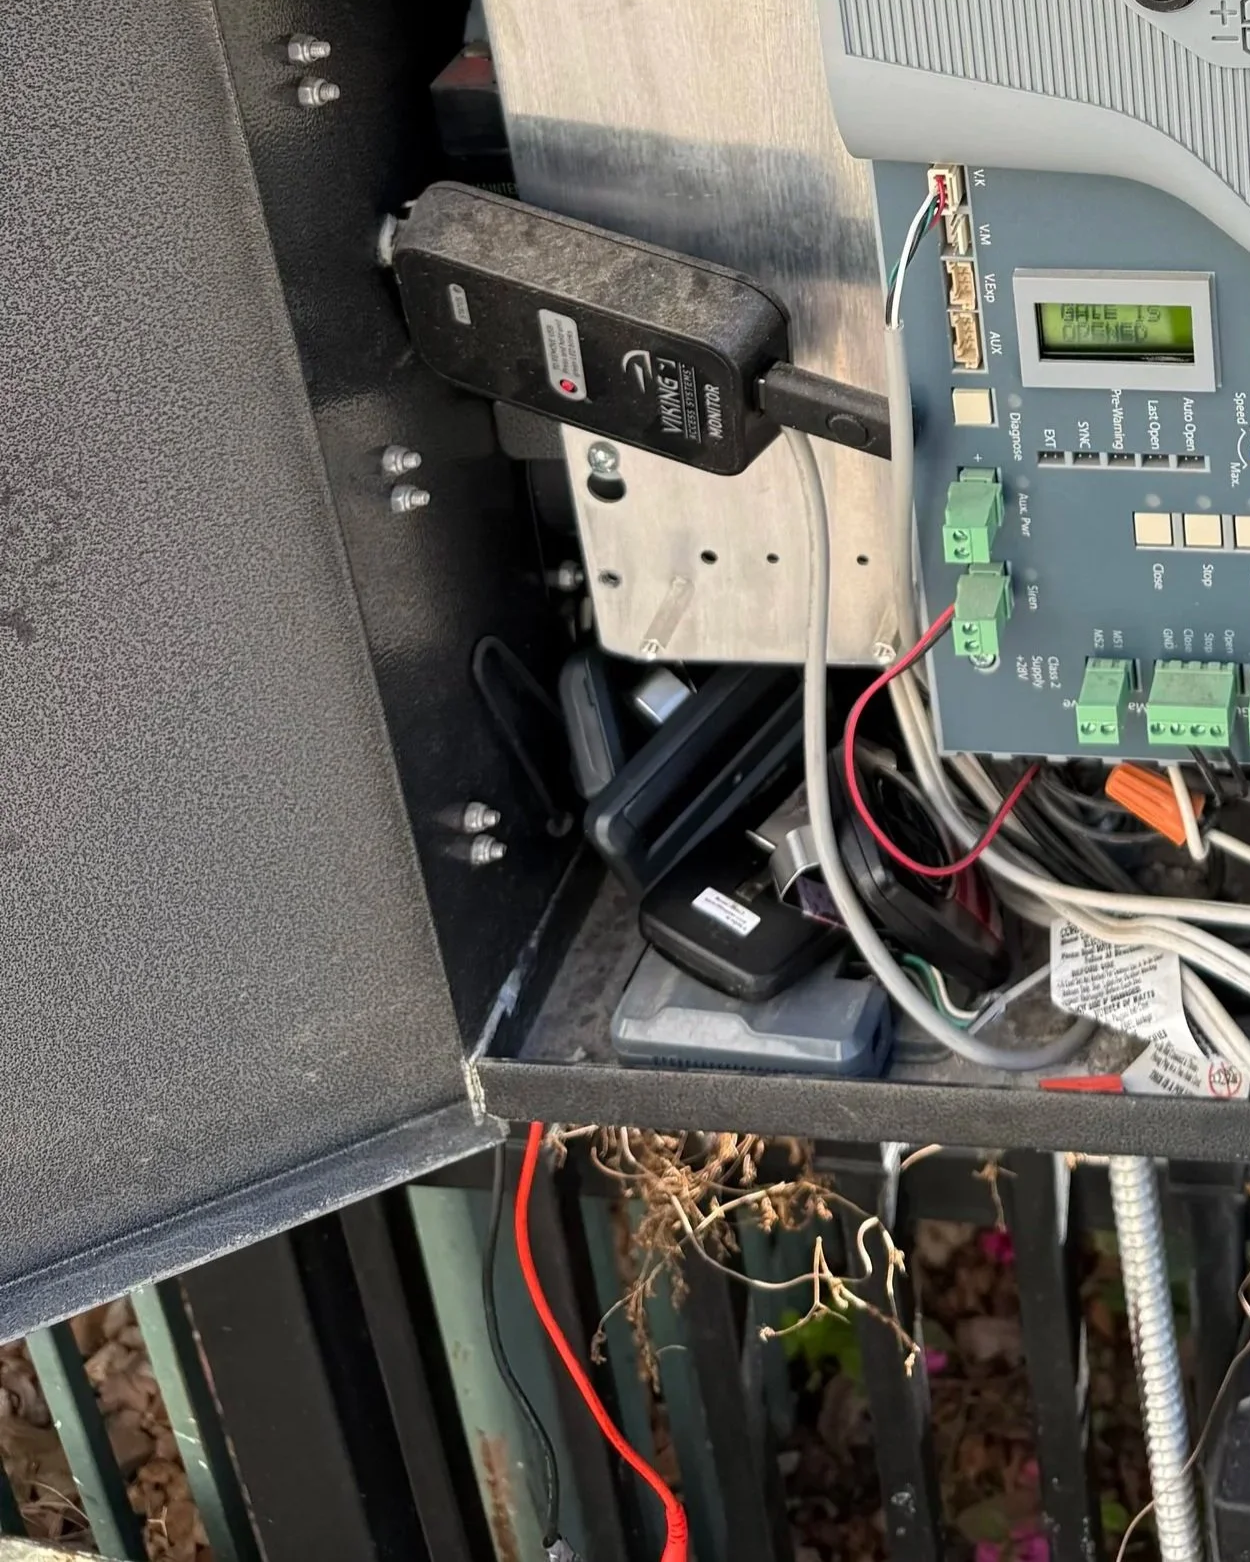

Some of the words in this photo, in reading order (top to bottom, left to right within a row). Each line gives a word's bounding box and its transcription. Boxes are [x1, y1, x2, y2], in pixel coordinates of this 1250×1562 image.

[973, 169, 985, 187] V.K
[979, 224, 992, 245] V.M
[983, 273, 996, 303] V.Exp
[1136, 305, 1161, 322] IS
[989, 332, 1001, 354] AUX
[1062, 322, 1148, 343] OPENED
[657, 374, 683, 433] VIKING
[704, 383, 723, 439] MONITOR
[1148, 400, 1160, 420] Last
[1183, 397, 1195, 423] Auto
[1237, 392, 1247, 425] Speed
[1112, 389, 1125, 451] Pre-Warning
[1009, 412, 1023, 462] Diagnose
[1044, 429, 1056, 449] EXT
[1078, 422, 1091, 449] SYNC
[1149, 422, 1161, 450] Open
[1184, 424, 1197, 452] Open
[1230, 462, 1241, 488] Max.
[1152, 563, 1165, 590] Close
[1202, 564, 1214, 588] Stop
[1027, 585, 1038, 610] Siren
[1032, 656, 1043, 688] Supply
[1048, 656, 1059, 679] Class
